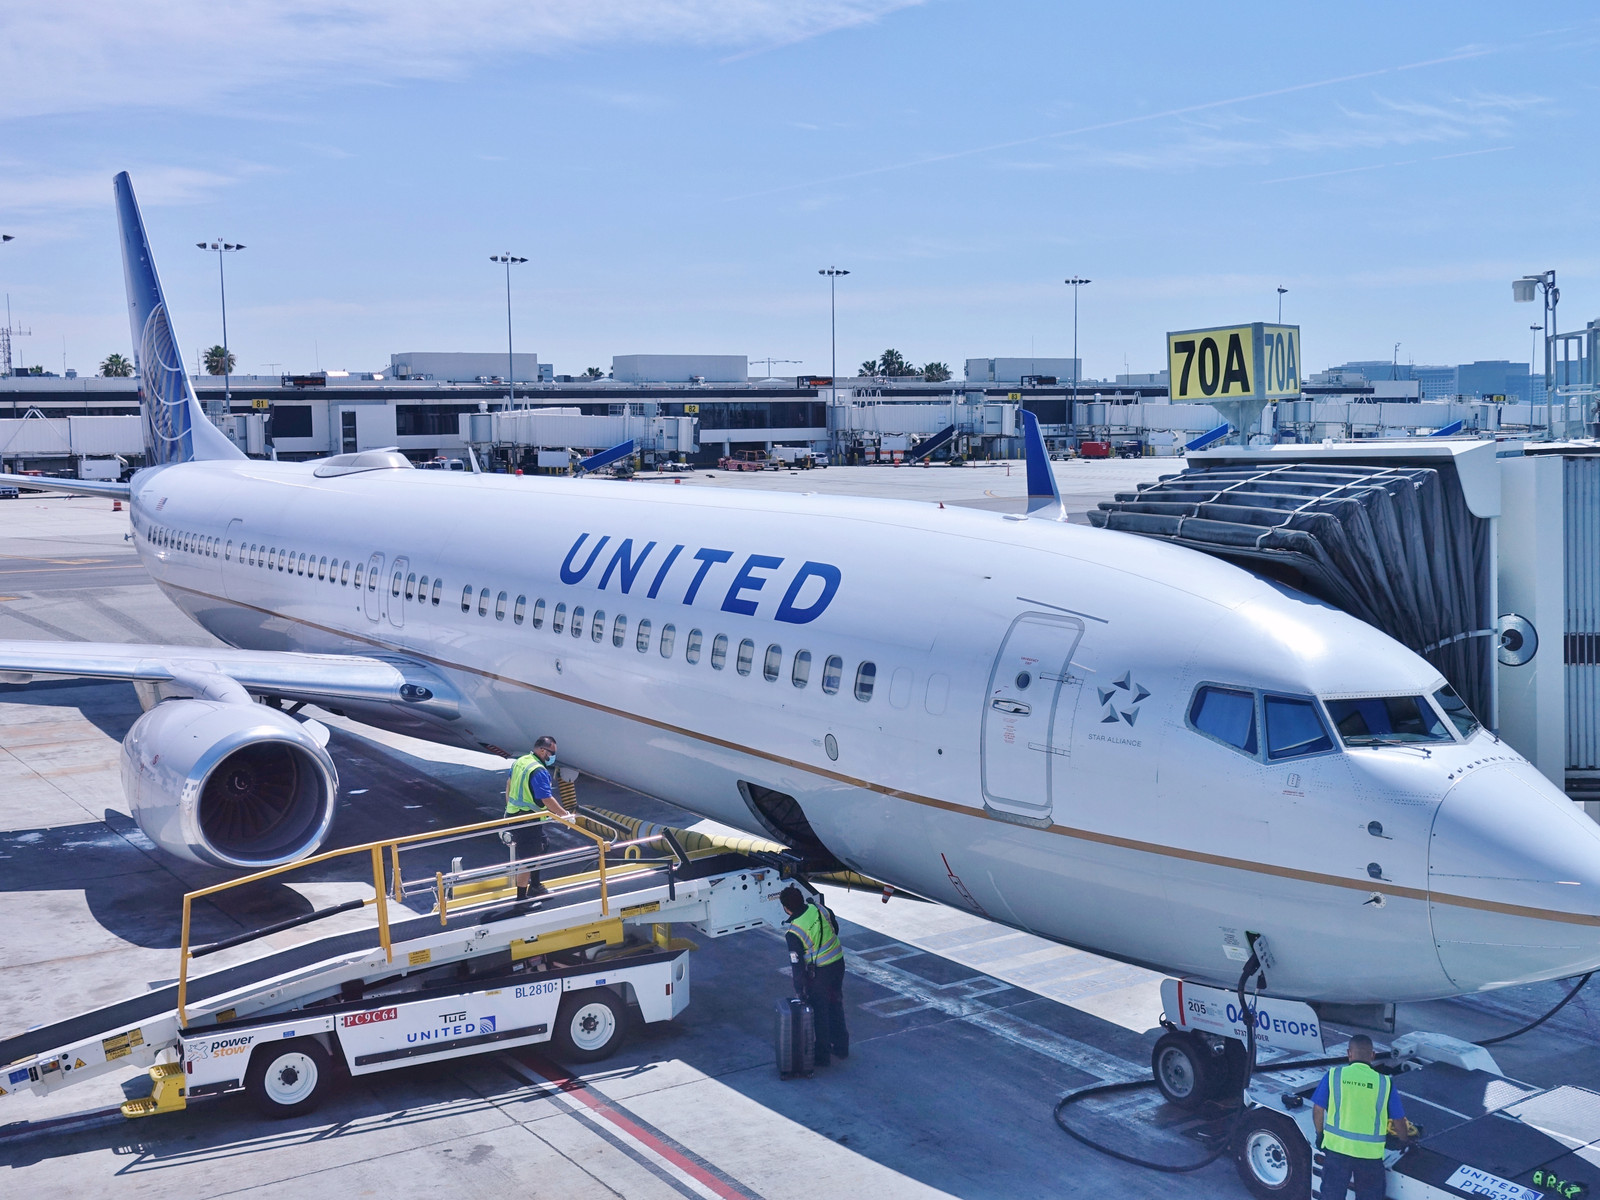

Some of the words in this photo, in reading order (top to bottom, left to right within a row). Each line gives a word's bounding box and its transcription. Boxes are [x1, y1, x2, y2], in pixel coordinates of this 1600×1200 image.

[1174, 333, 1251, 396] 70A
[1264, 331, 1298, 391] 70A
[256, 400, 264, 408] 81
[559, 532, 842, 625] UNITED
[1088, 733, 1106, 742] STAR
[1108, 736, 1142, 748] ALLIANCE
[515, 982, 554, 998] BL2810
[1188, 1001, 1207, 1014] 205
[346, 1010, 396, 1026] PC9C64
[407, 1023, 476, 1043] UNITED
[1273, 1019, 1318, 1037] ETOPS
[210, 1035, 254, 1052] power
[213, 1045, 246, 1058] stow
[1460, 1167, 1520, 1194] UNITED
[1460, 1180, 1516, 1200] PT053
